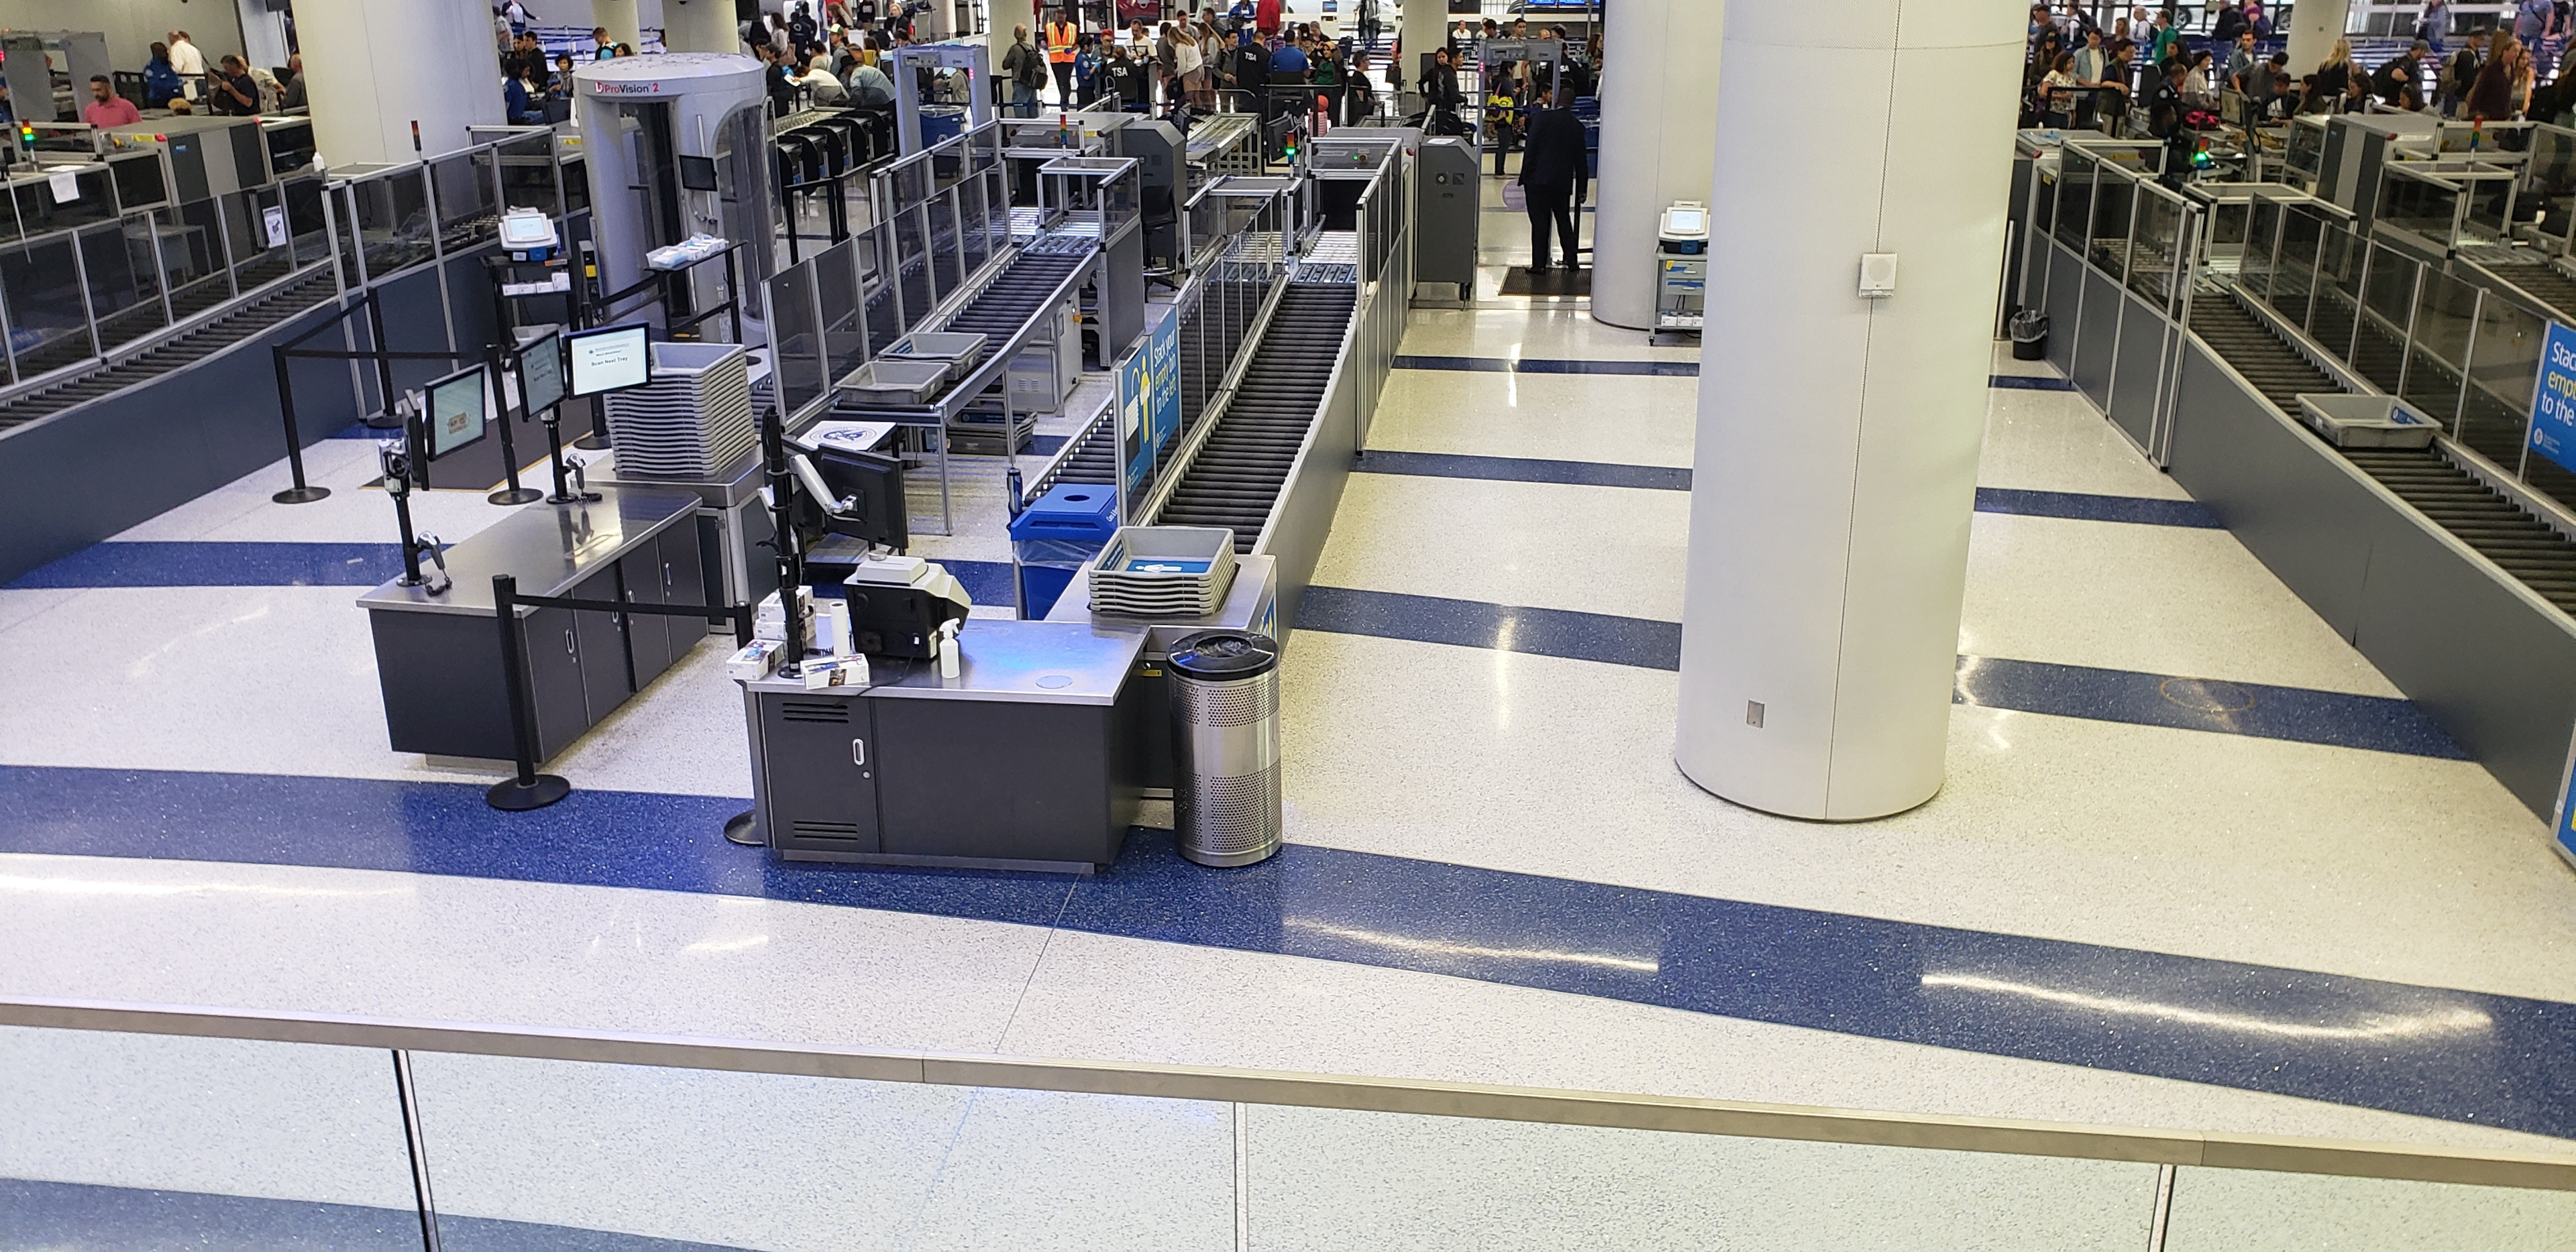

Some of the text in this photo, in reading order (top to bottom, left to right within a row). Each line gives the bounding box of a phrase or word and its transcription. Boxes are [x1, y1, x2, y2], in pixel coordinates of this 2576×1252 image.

[1111, 66, 1128, 77] TSA
[1244, 51, 1257, 62] TSA
[1559, 64, 1570, 72] SA
[604, 83, 649, 93] ProVision
[652, 82, 659, 93] 2
[1154, 328, 1175, 368] Stack your
[2551, 341, 2576, 372] Stac
[1155, 351, 1177, 392] empty bin
[2548, 370, 2576, 401] empt
[1157, 373, 1177, 415] to the left
[2541, 390, 2575, 426] to the
